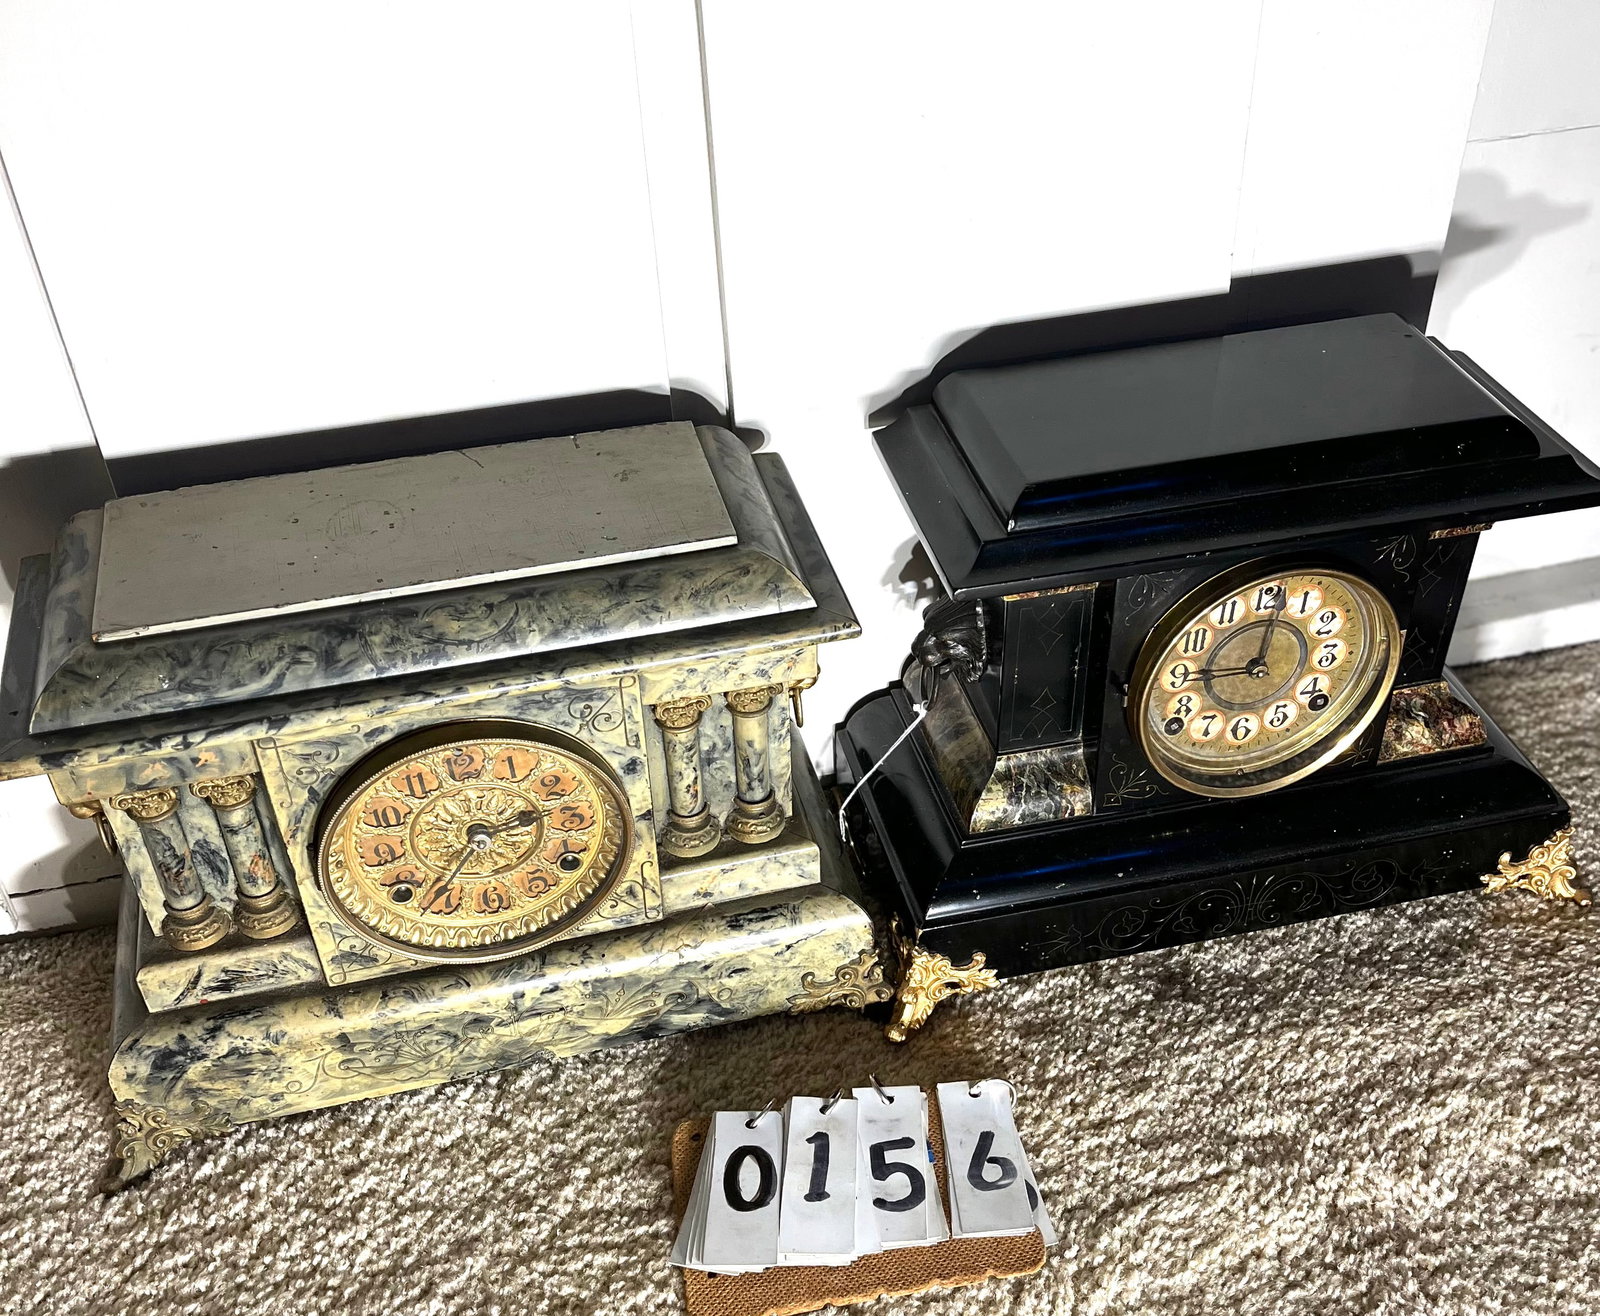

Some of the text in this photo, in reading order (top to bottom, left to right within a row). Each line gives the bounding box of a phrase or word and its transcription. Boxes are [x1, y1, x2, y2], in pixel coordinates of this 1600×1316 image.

[1218, 600, 1237, 626] 11
[1299, 590, 1310, 615] 1
[1315, 611, 1338, 636] 2
[1183, 627, 1207, 655] 10
[1317, 643, 1338, 668] 3
[1169, 663, 1190, 689] 9
[1173, 694, 1193, 717] 8
[1269, 703, 1289, 727] 5
[1200, 713, 1217, 738] 7
[1230, 717, 1252, 741] 6
[504, 754, 519, 779] 1
[402, 772, 427, 796] 11
[543, 775, 567, 797] 2
[372, 805, 401, 828] 10
[560, 805, 585, 829] 3
[373, 844, 396, 866] 9
[526, 867, 549, 893] 5
[482, 886, 504, 909] 6
